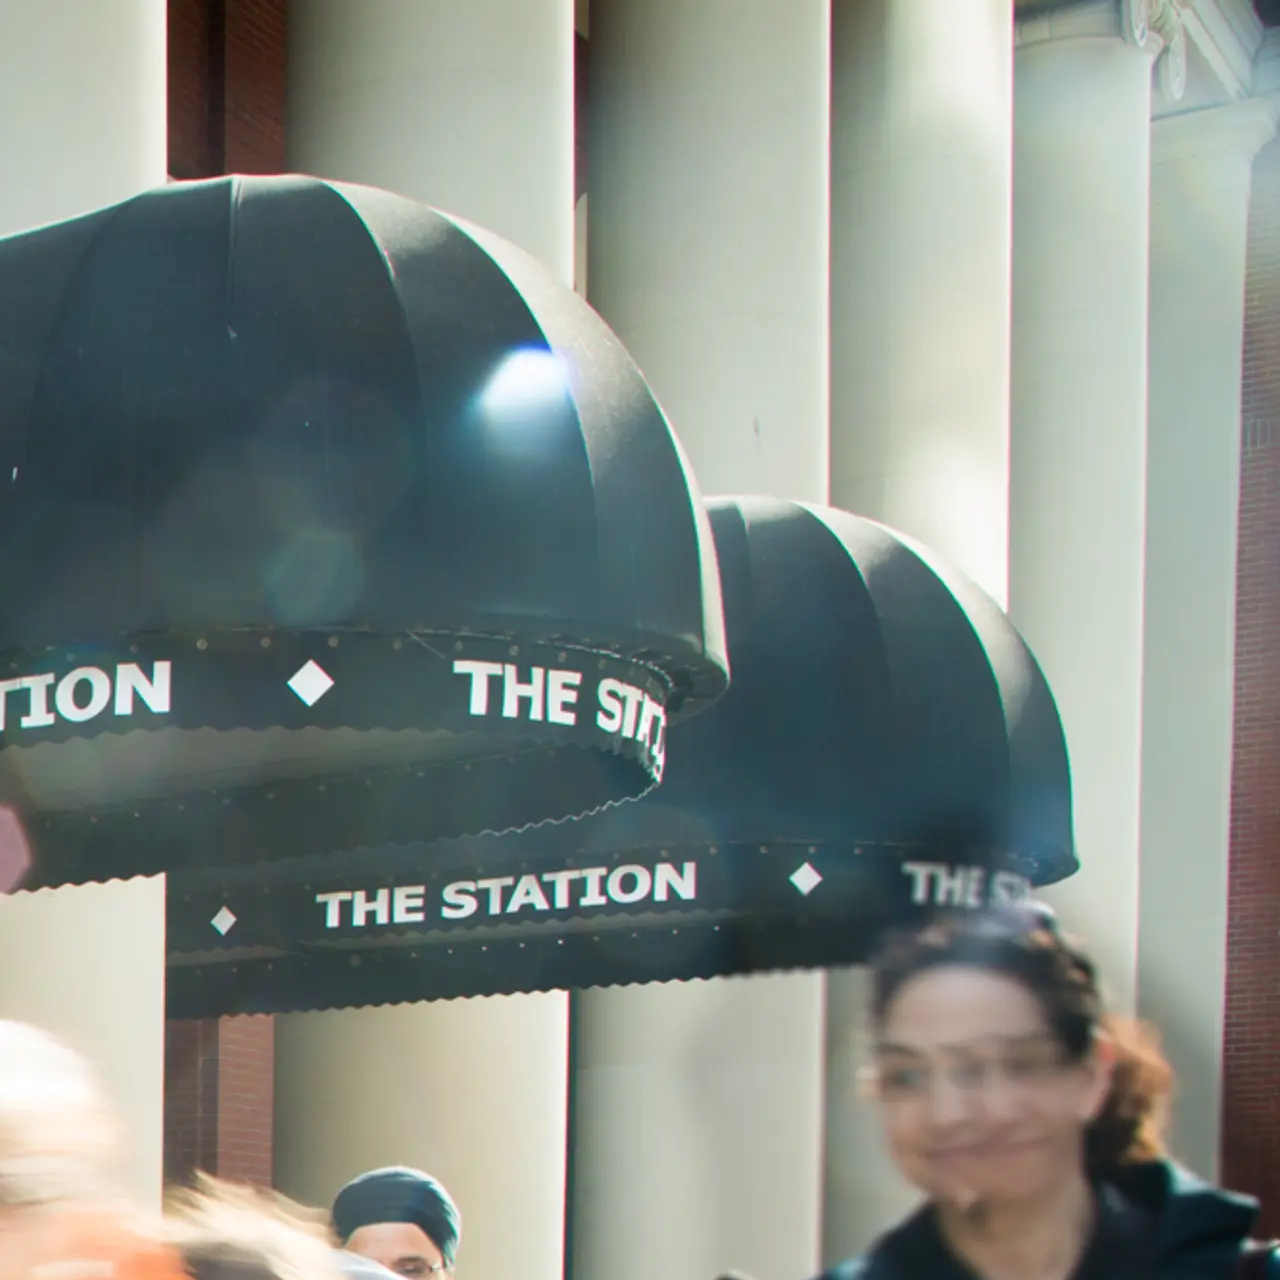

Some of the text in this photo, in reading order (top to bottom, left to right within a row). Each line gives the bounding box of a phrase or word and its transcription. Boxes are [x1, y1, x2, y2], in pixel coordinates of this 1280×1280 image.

[452, 659, 583, 726] THE
[315, 861, 697, 929] THE STATION
[900, 860, 986, 909] THE
